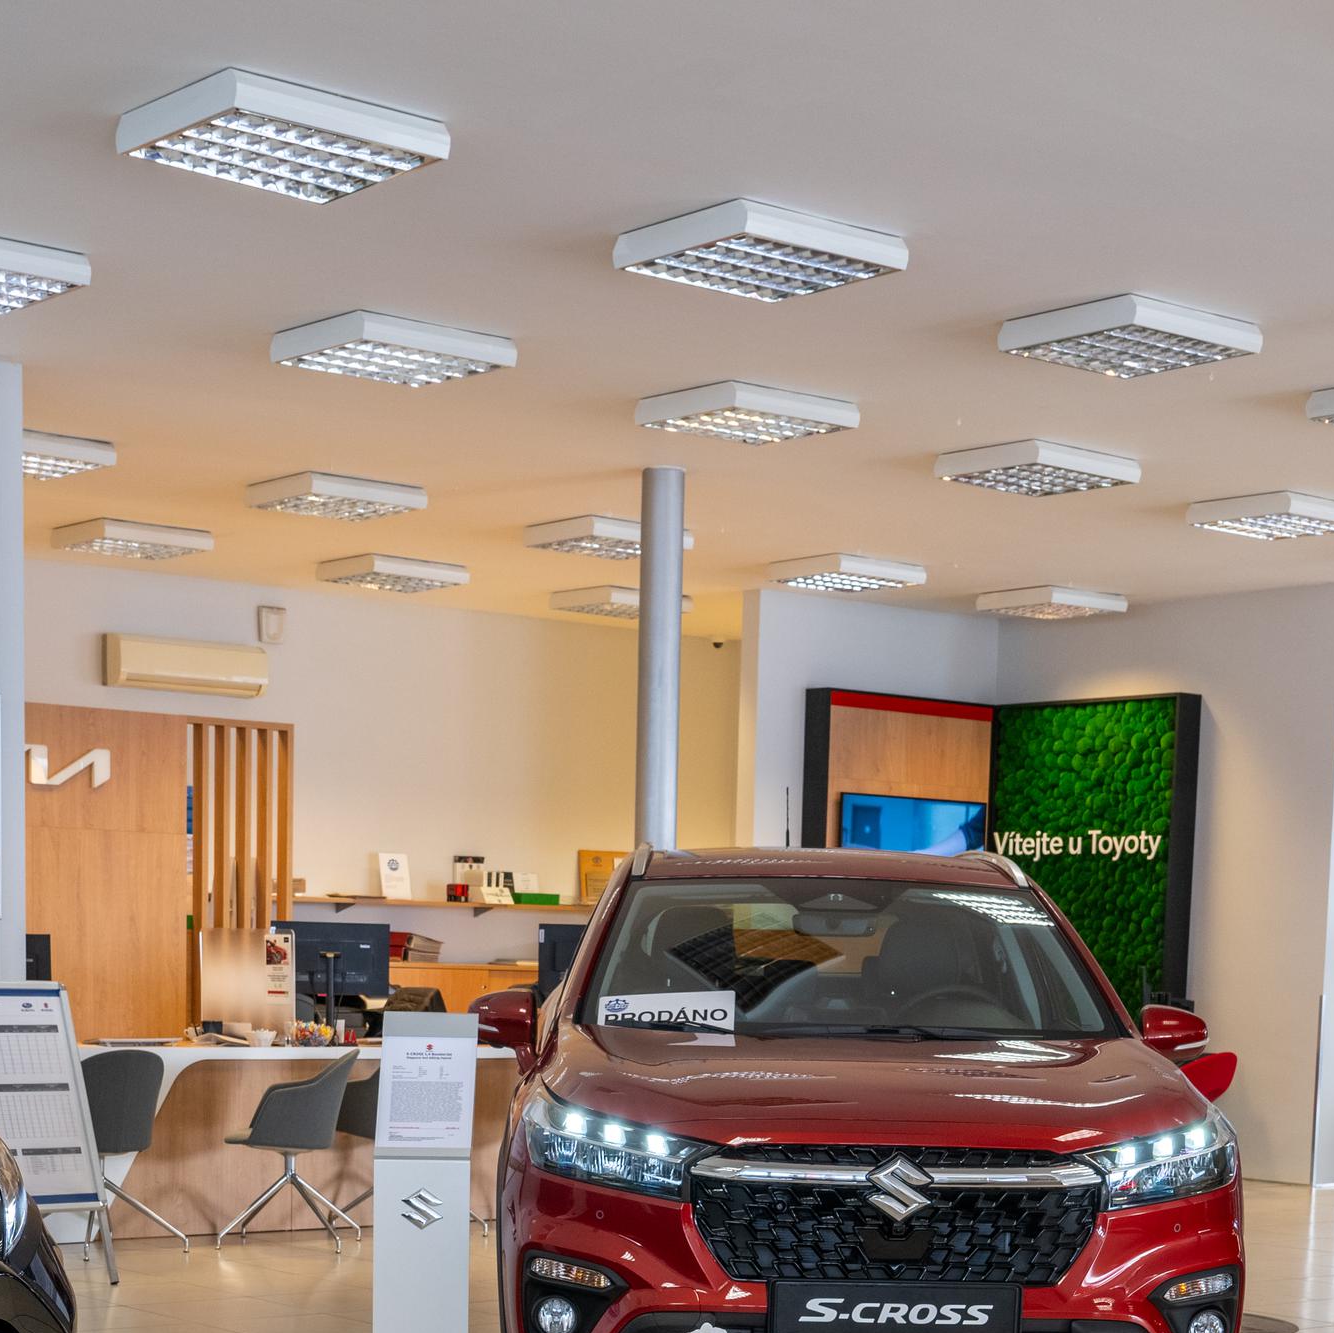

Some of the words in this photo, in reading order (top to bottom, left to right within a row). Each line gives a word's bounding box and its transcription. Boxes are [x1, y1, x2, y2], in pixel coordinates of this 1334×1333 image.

[993, 830, 1064, 862] Vítejte
[1068, 836, 1082, 854] u
[1088, 829, 1162, 862] Toyoty
[798, 1298, 994, 1326] S-CROSS
